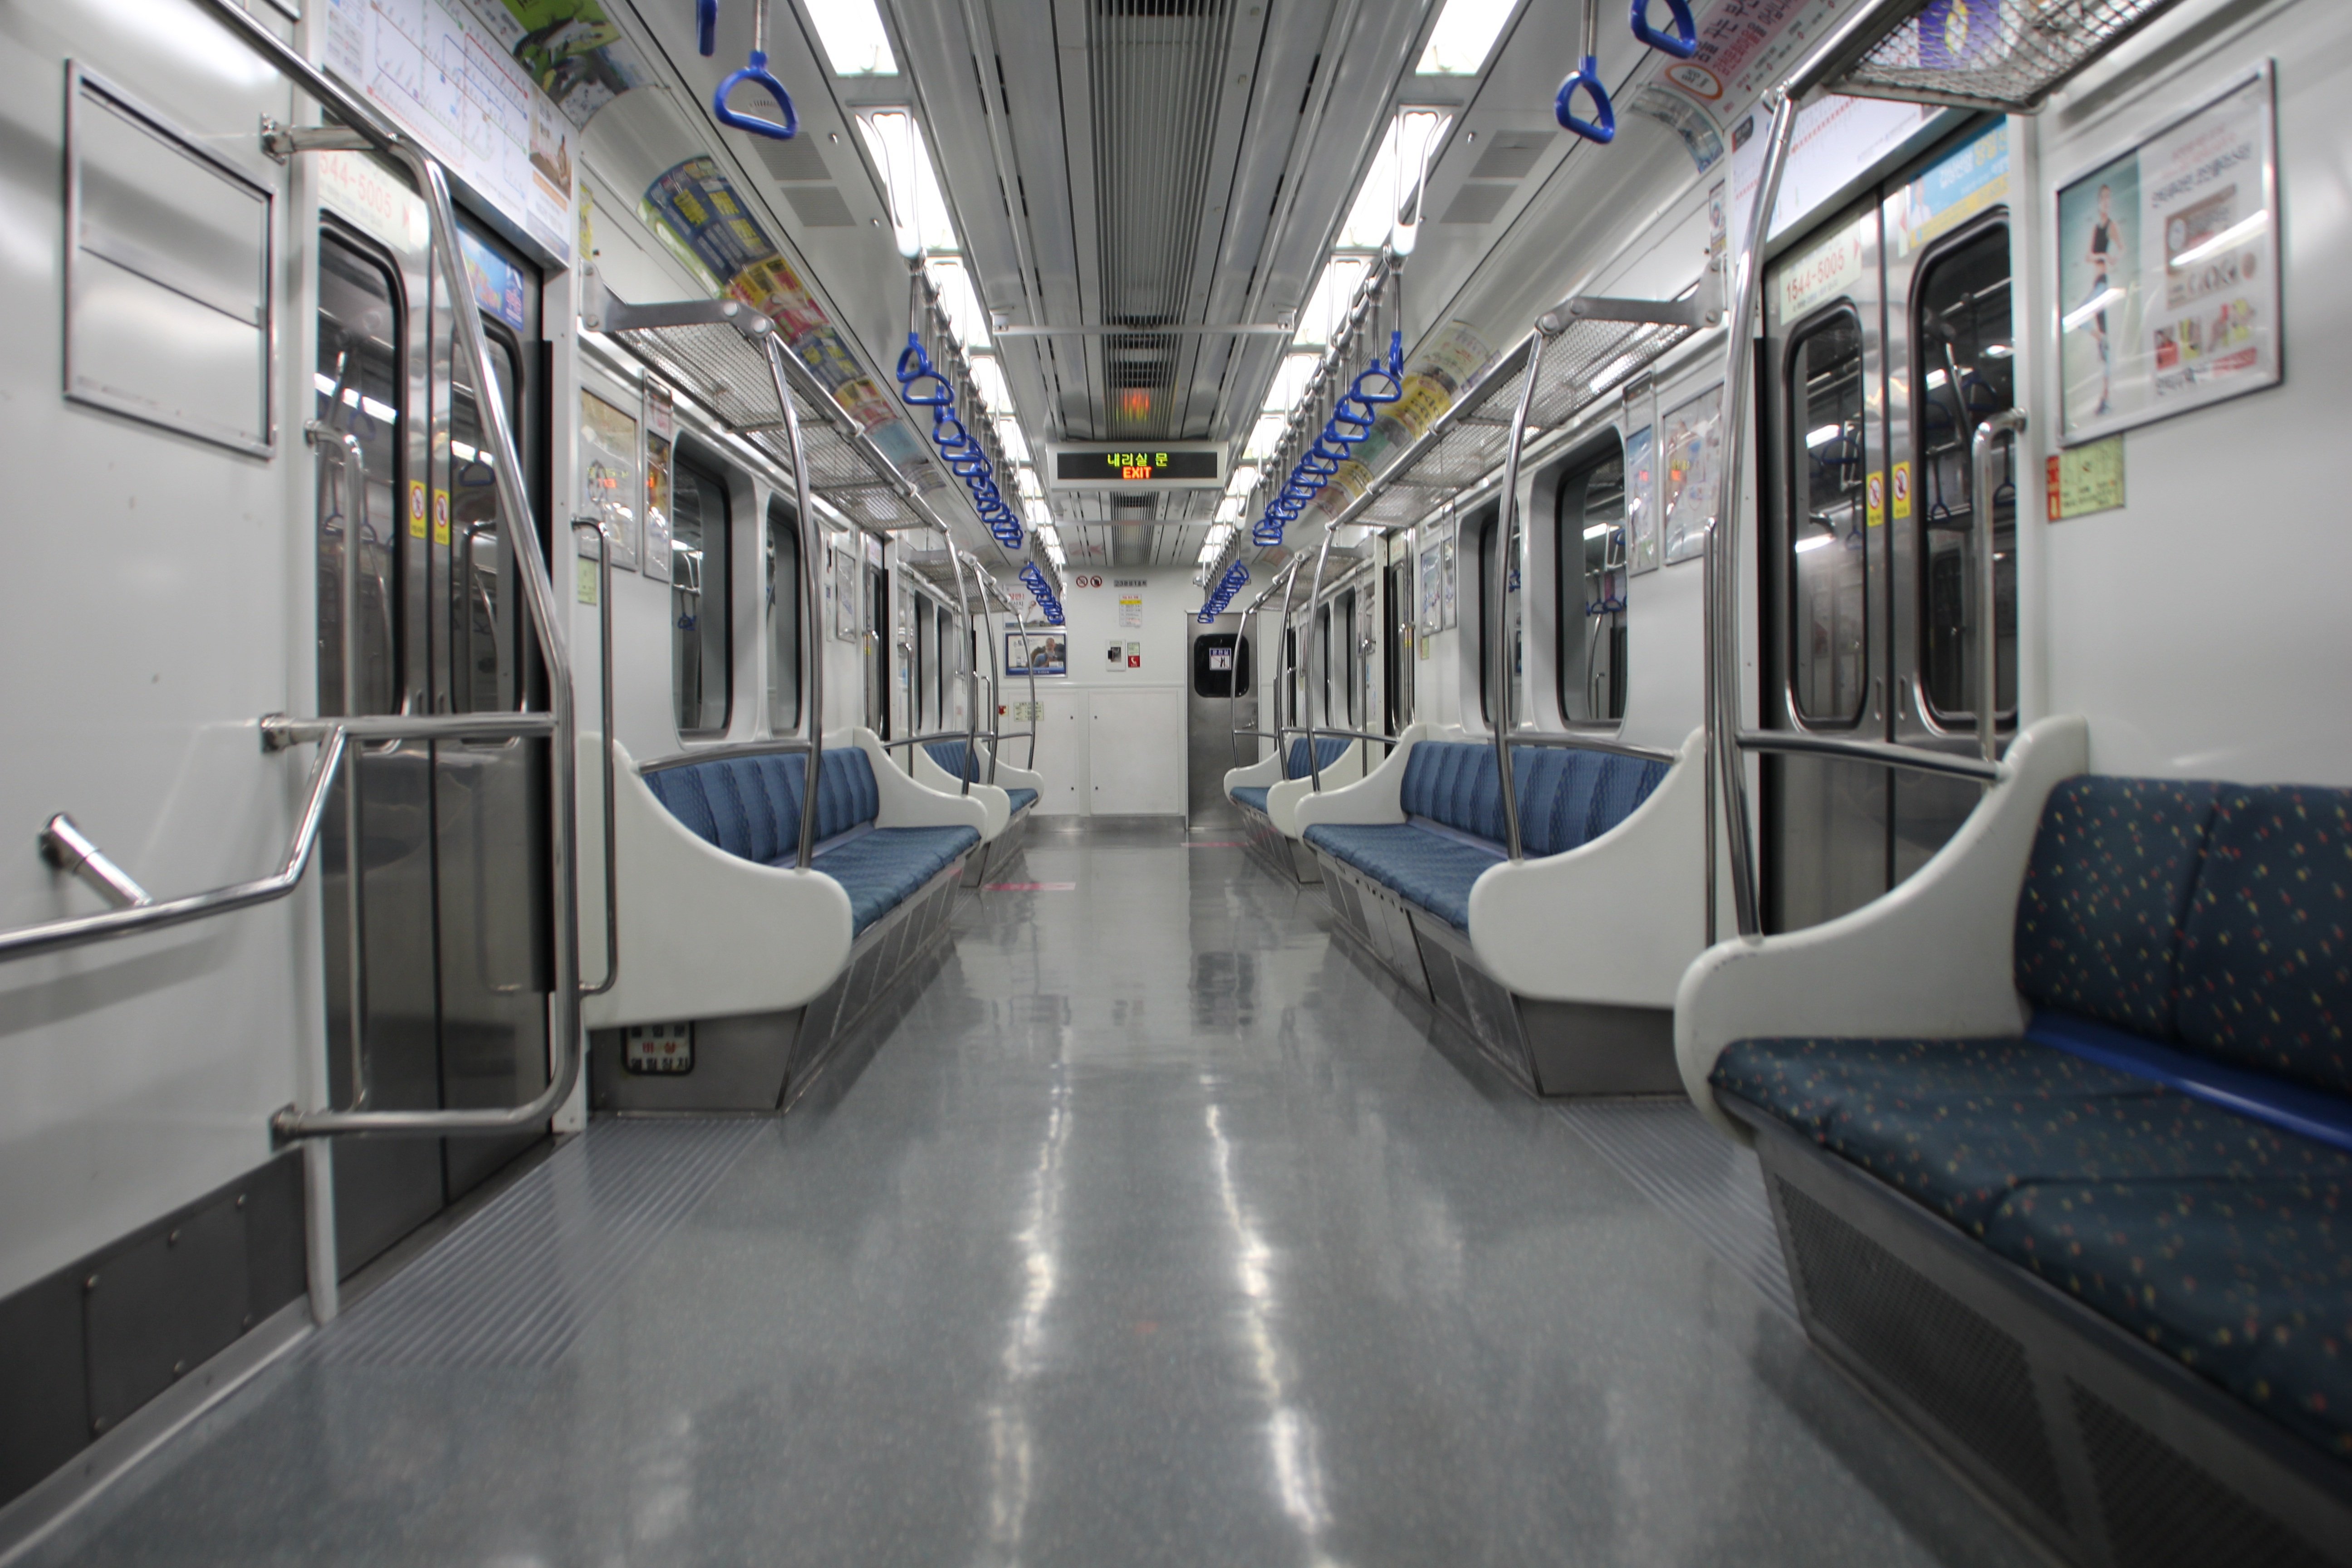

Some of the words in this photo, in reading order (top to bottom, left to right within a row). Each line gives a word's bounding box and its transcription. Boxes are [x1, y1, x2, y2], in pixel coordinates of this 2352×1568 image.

[319, 153, 392, 219] 544-5005
[1786, 247, 1846, 303] 1544-5005
[1107, 452, 1148, 467] 내리실
[1155, 452, 1168, 467] 문
[1122, 466, 1152, 479] EXIT
